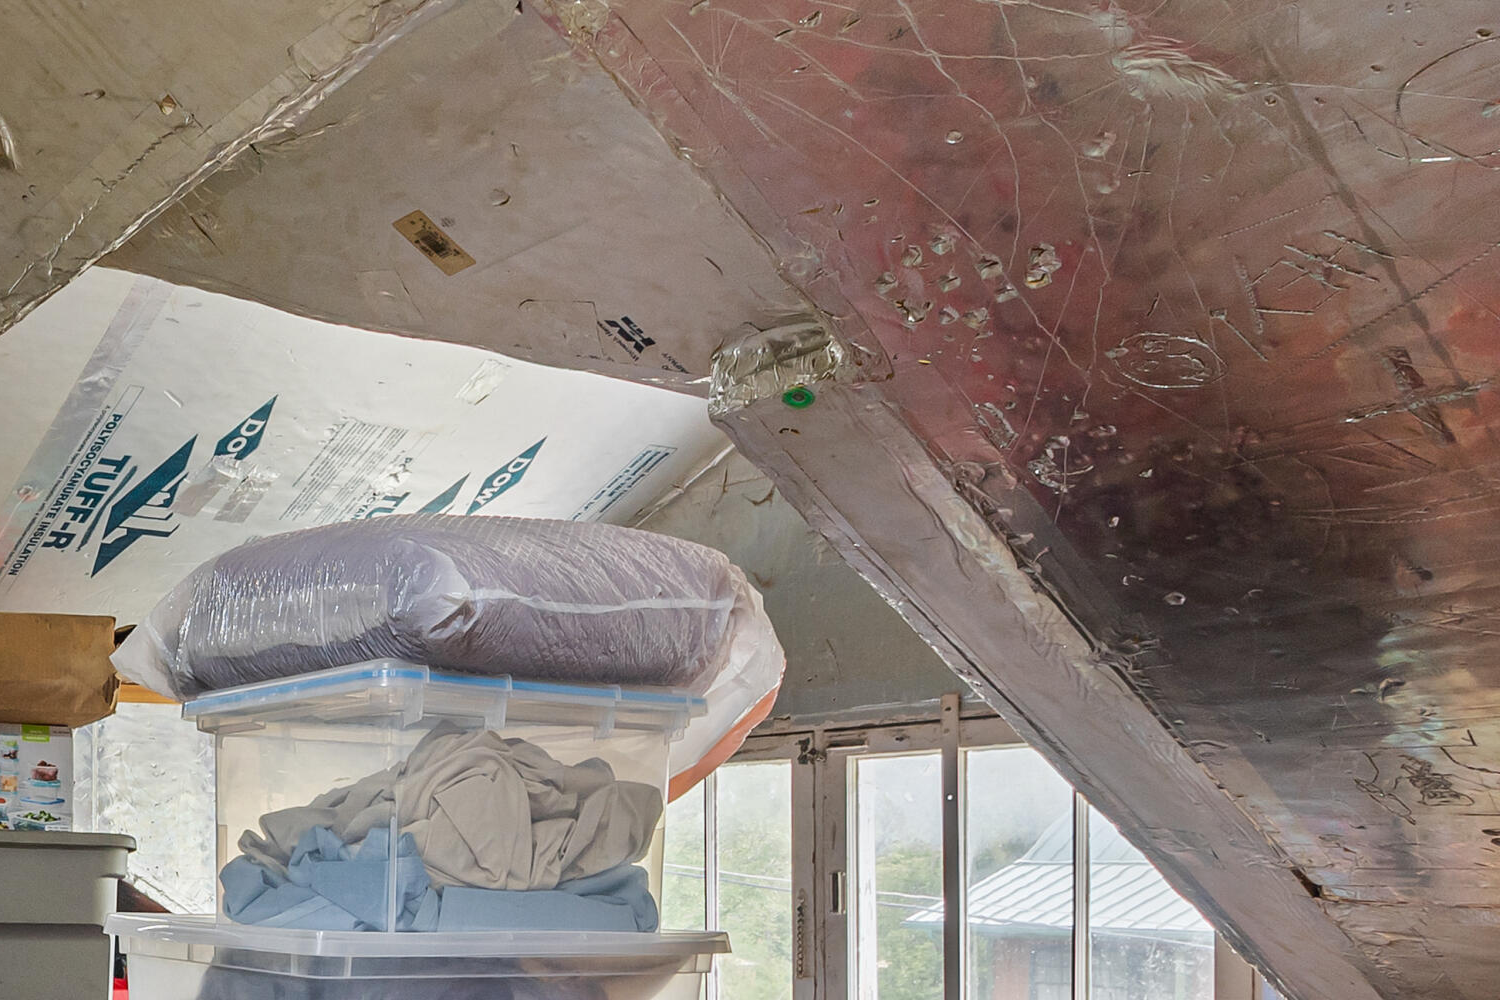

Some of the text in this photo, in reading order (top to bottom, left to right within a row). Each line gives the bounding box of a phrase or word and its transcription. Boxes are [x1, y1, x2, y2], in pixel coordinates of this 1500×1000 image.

[44, 413, 122, 520] POLYISOCYANURATE
[224, 418, 267, 456] DO
[475, 436, 532, 507] DOW
[7, 521, 50, 576] INSULATION
